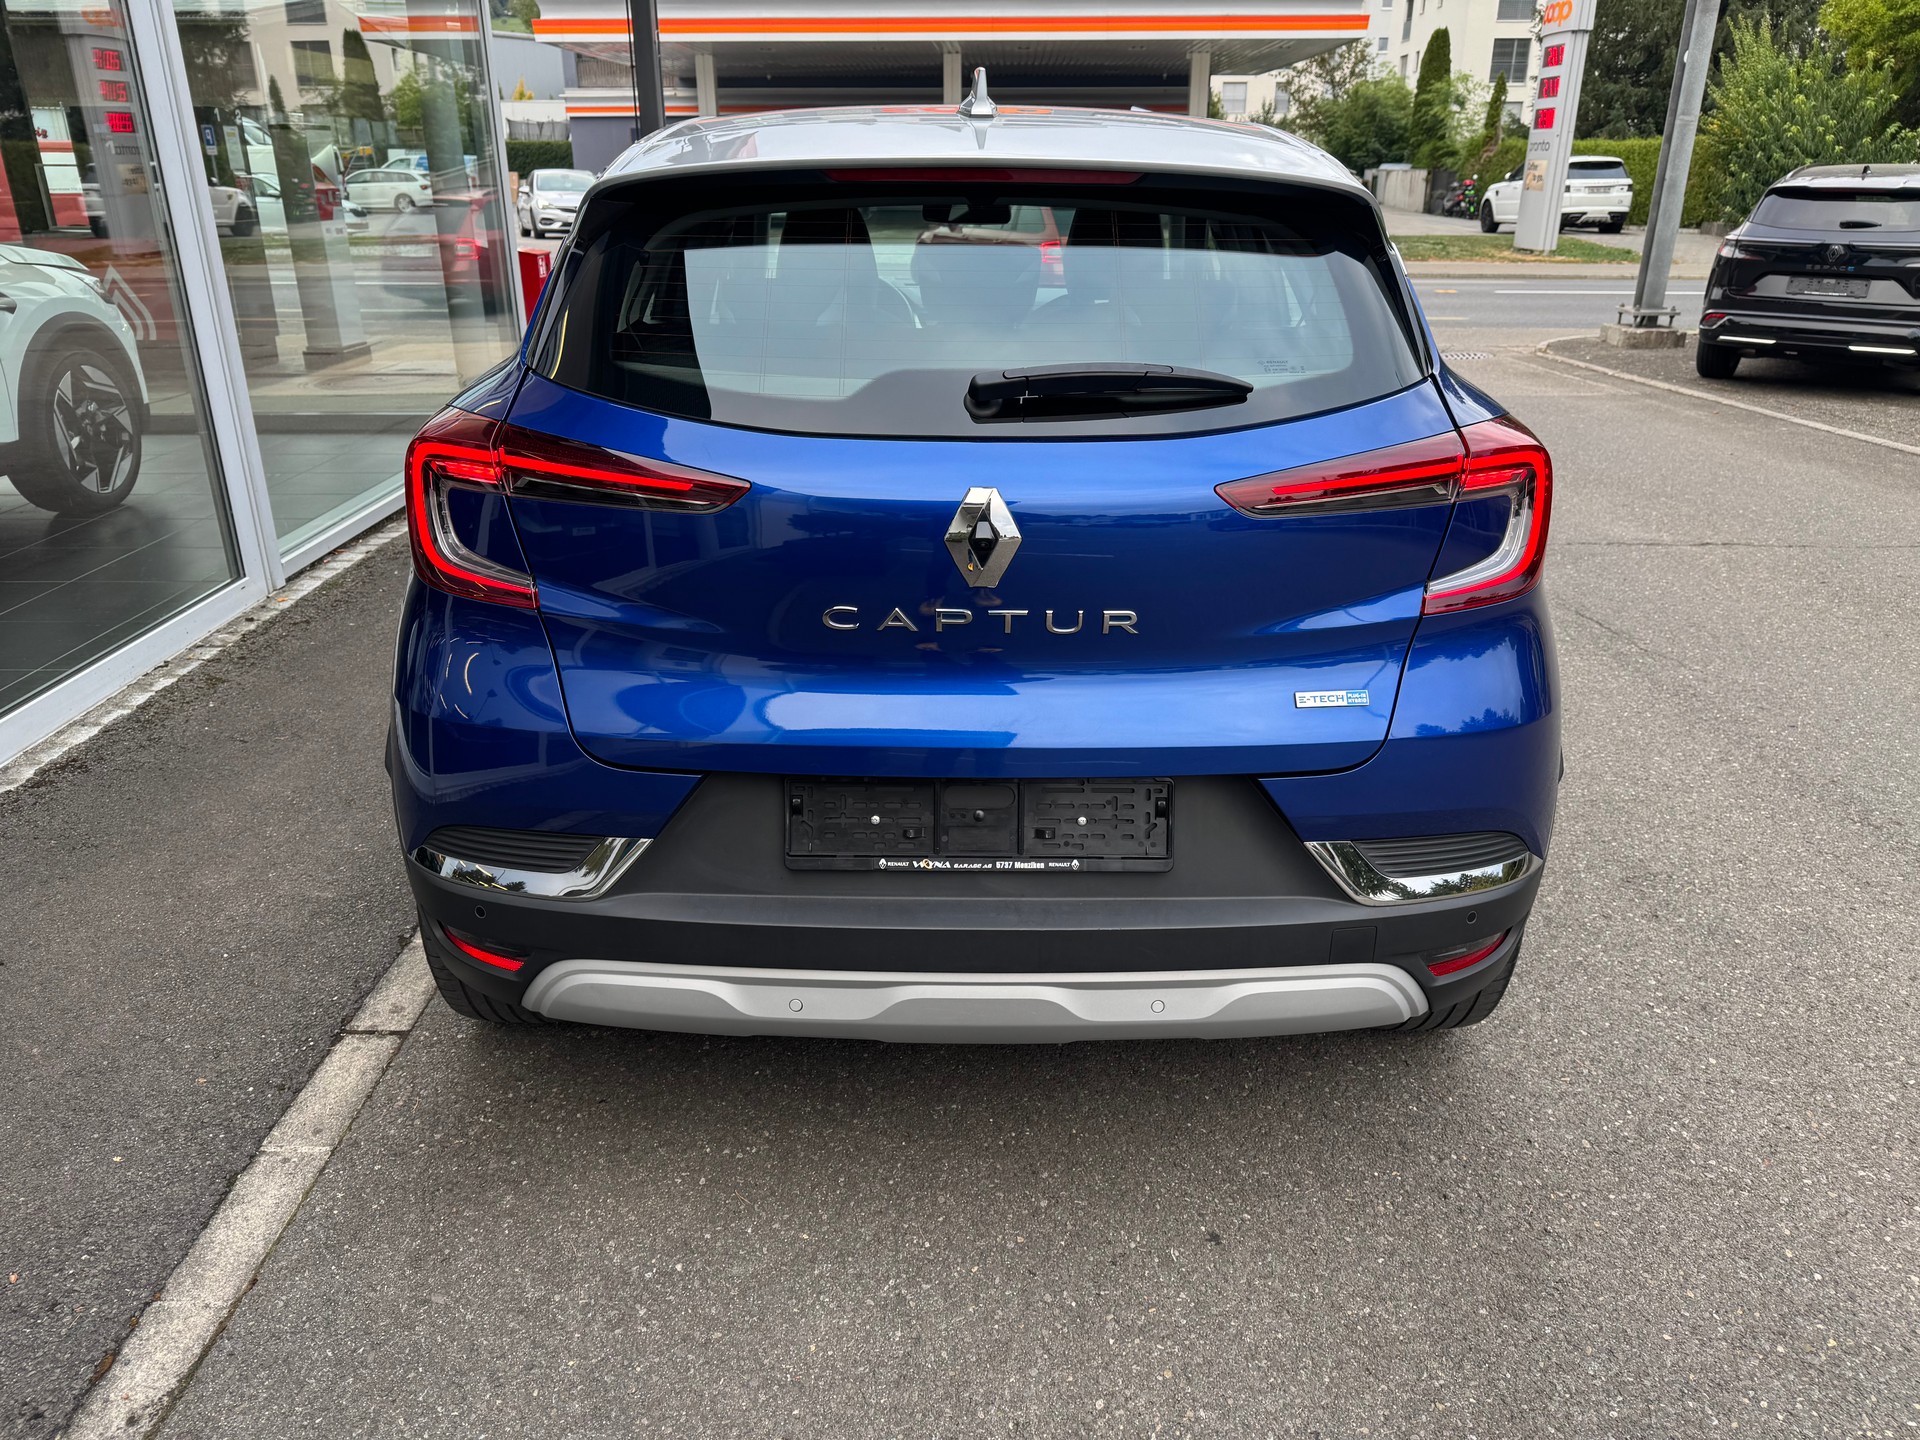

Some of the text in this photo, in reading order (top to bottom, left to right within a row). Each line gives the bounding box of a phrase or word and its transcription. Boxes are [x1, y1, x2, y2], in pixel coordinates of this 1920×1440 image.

[822, 605, 1139, 635] CAPTUR
[1298, 694, 1345, 704] E-TECH
[996, 861, 1013, 869] 5737
[1014, 861, 1045, 869] Menziken
